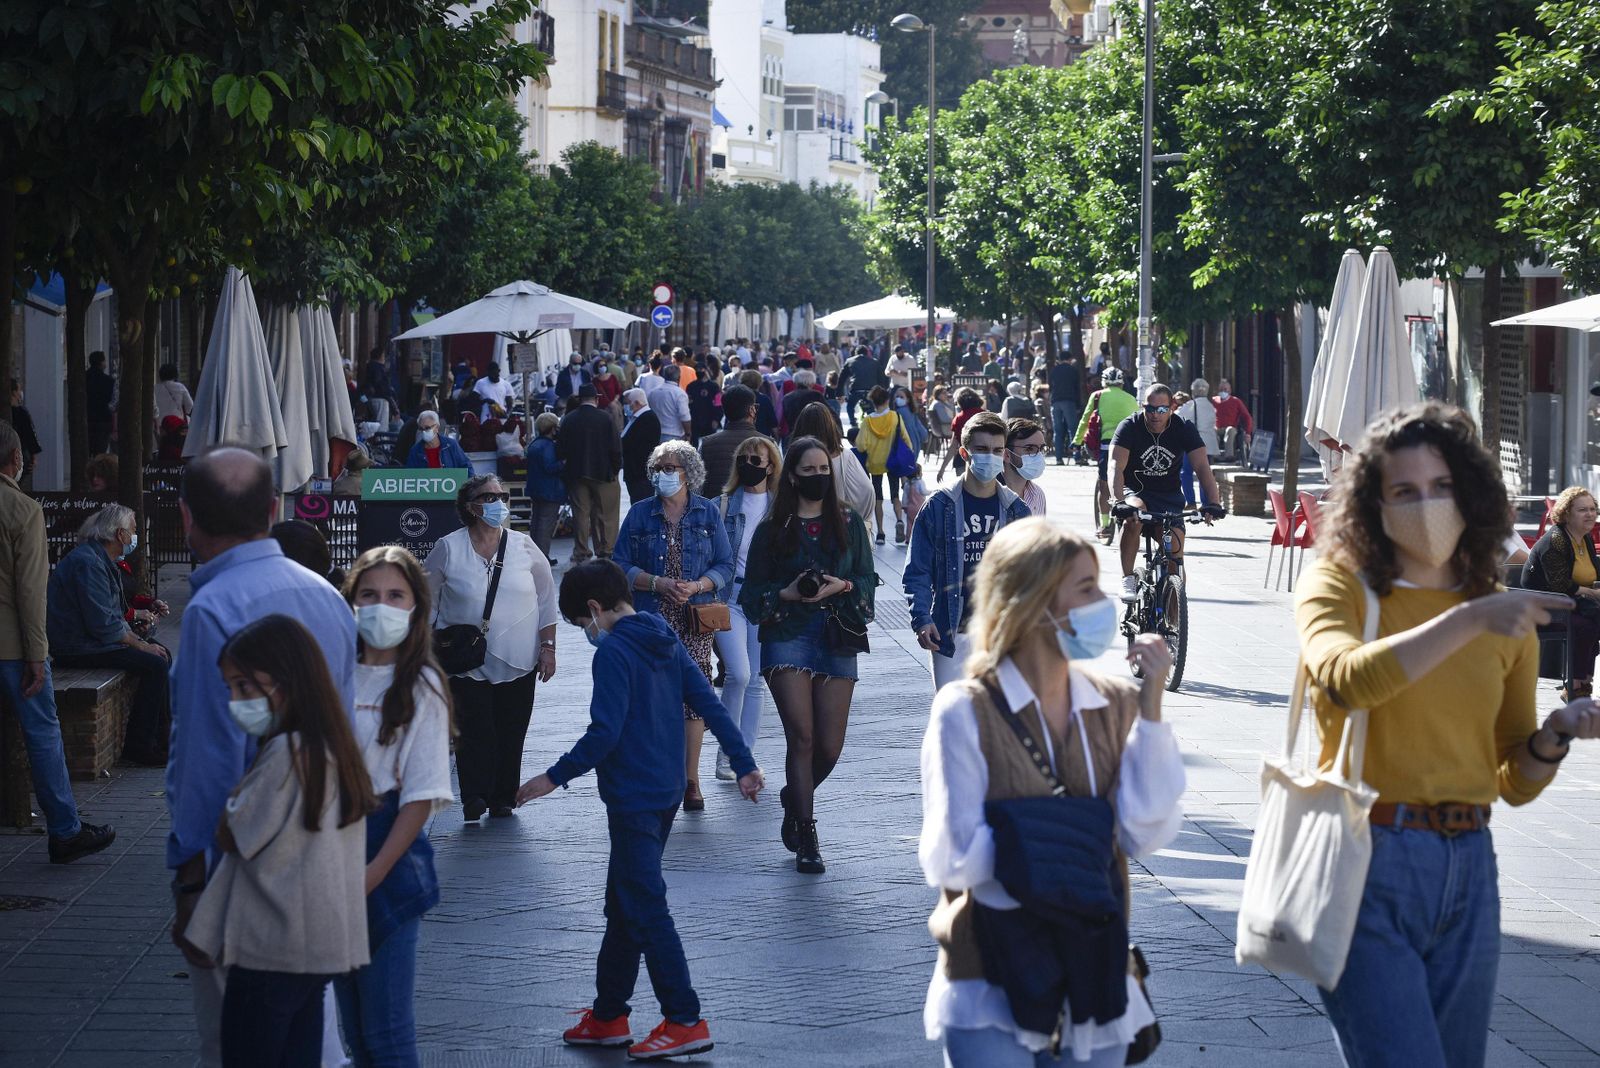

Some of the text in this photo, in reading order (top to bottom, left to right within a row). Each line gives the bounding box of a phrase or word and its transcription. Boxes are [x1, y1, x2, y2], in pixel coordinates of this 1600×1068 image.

[371, 478, 457, 494] ABIERTO
[333, 500, 357, 514] MA
[410, 549, 431, 557] GENT
[963, 552, 982, 562] CAD
